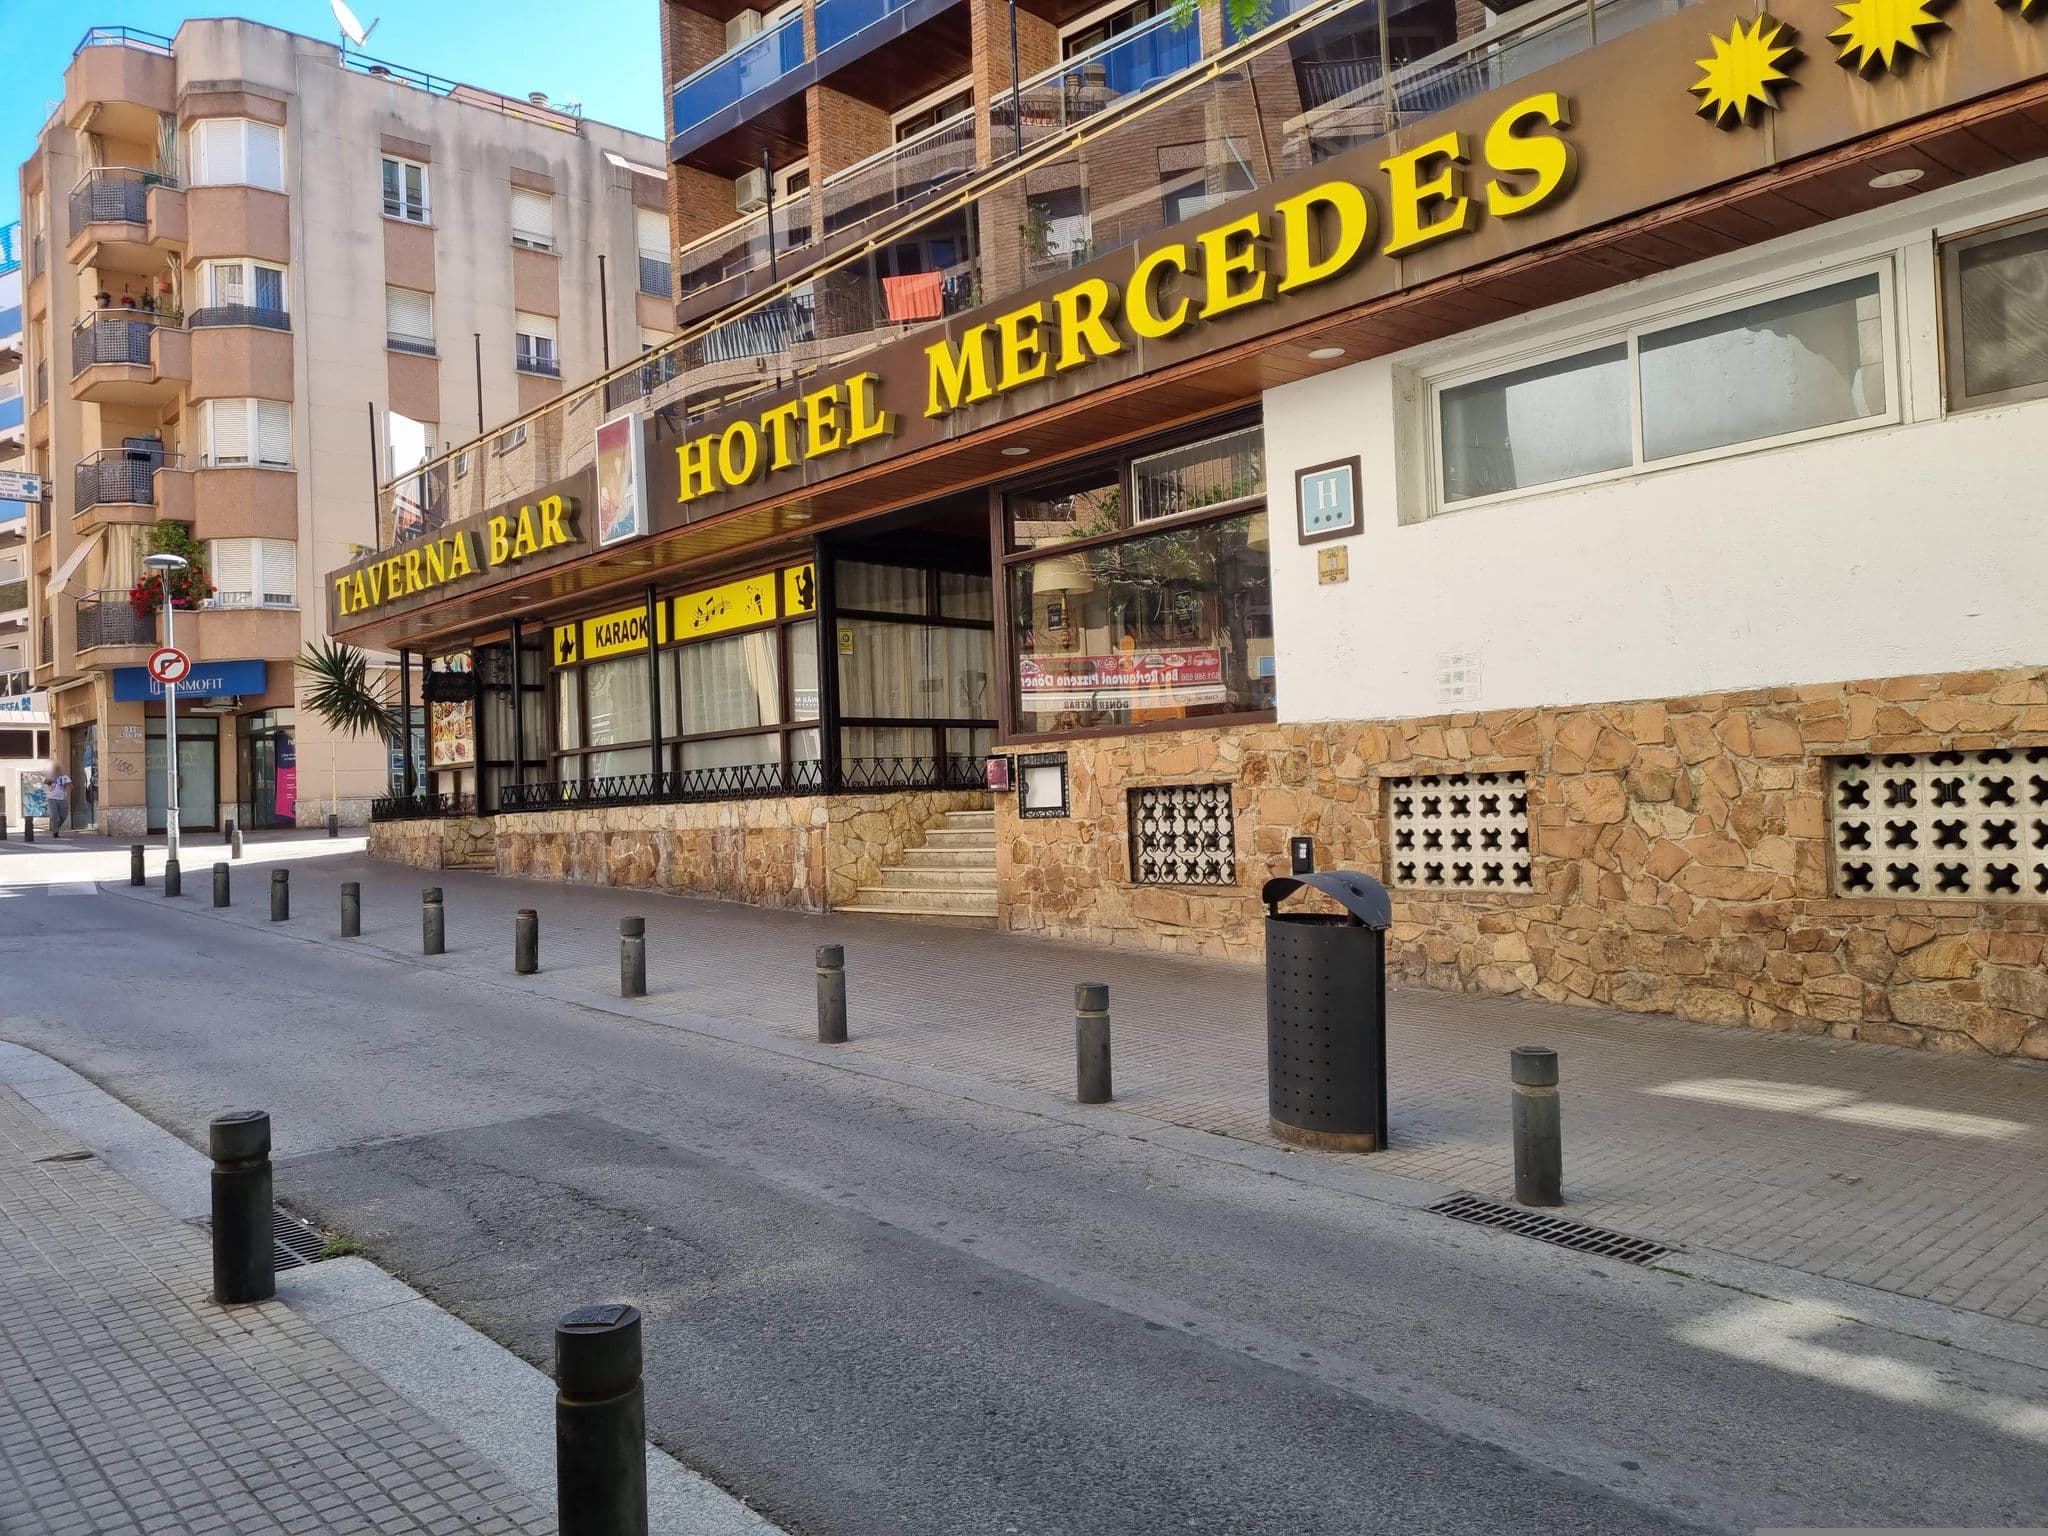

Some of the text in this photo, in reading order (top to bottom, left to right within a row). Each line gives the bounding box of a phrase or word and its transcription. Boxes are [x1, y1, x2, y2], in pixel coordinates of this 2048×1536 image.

[676, 91, 1574, 504] HOTEL MERCEDES
[1316, 477, 1338, 511] H
[335, 494, 574, 617] TAVERNA BAR
[595, 615, 648, 648] KARAOK
[175, 677, 225, 691] NMOFIT
